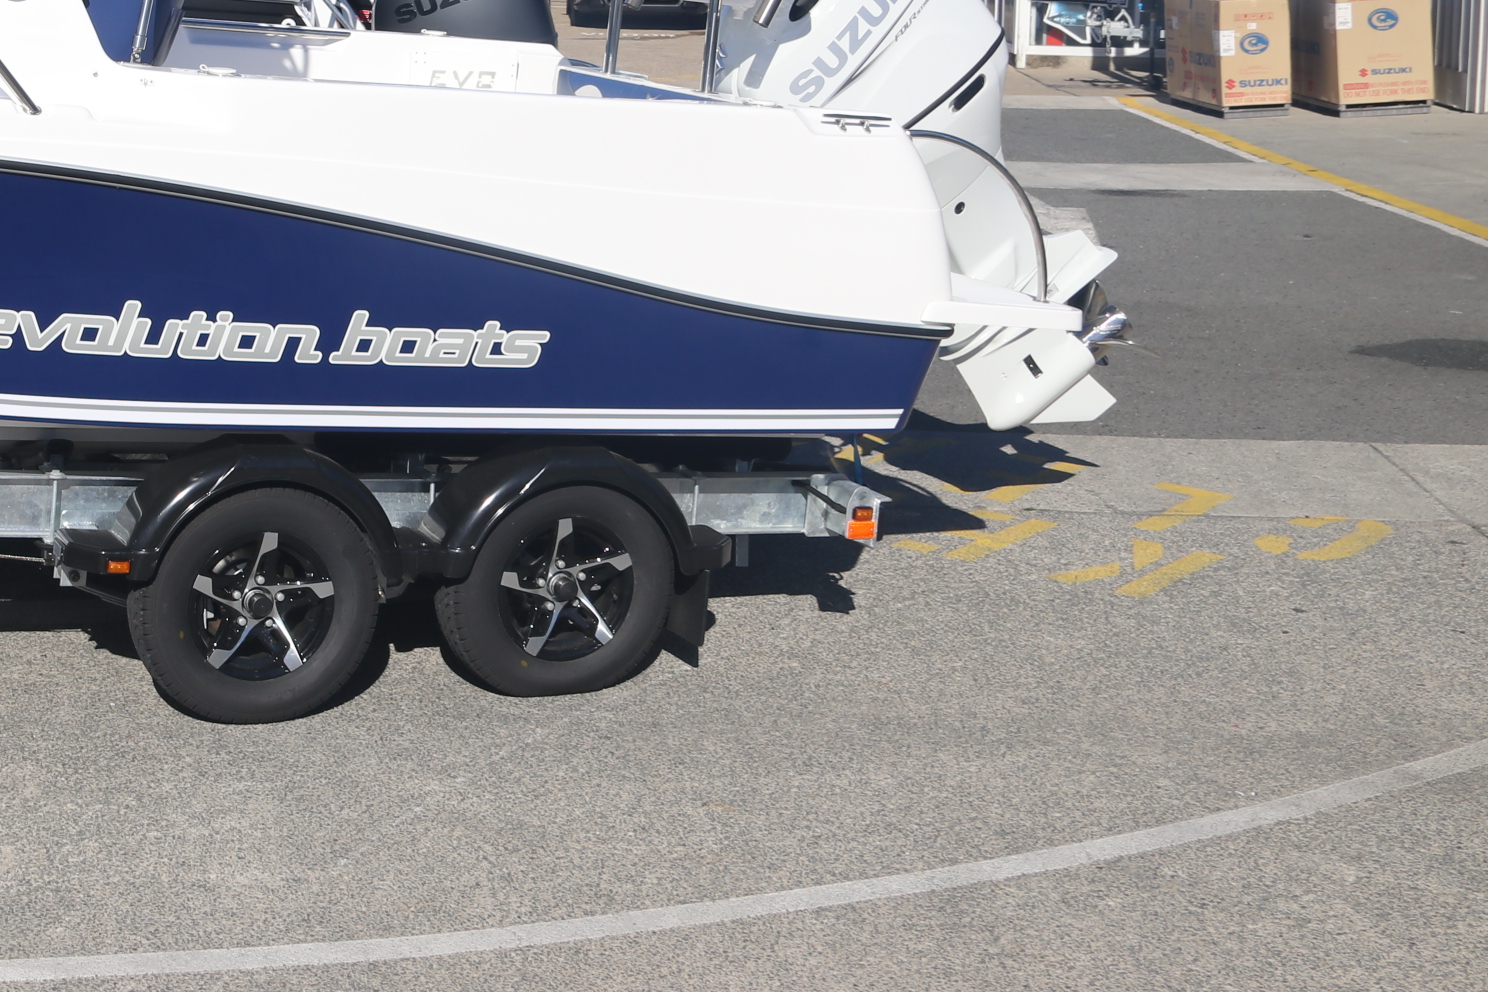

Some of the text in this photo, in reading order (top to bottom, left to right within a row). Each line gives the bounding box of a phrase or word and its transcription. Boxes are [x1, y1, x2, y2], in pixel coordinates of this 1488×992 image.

[1371, 67, 1412, 75] SUZUKI
[1239, 78, 1288, 88] SUZUKI
[329, 309, 551, 368] boats
